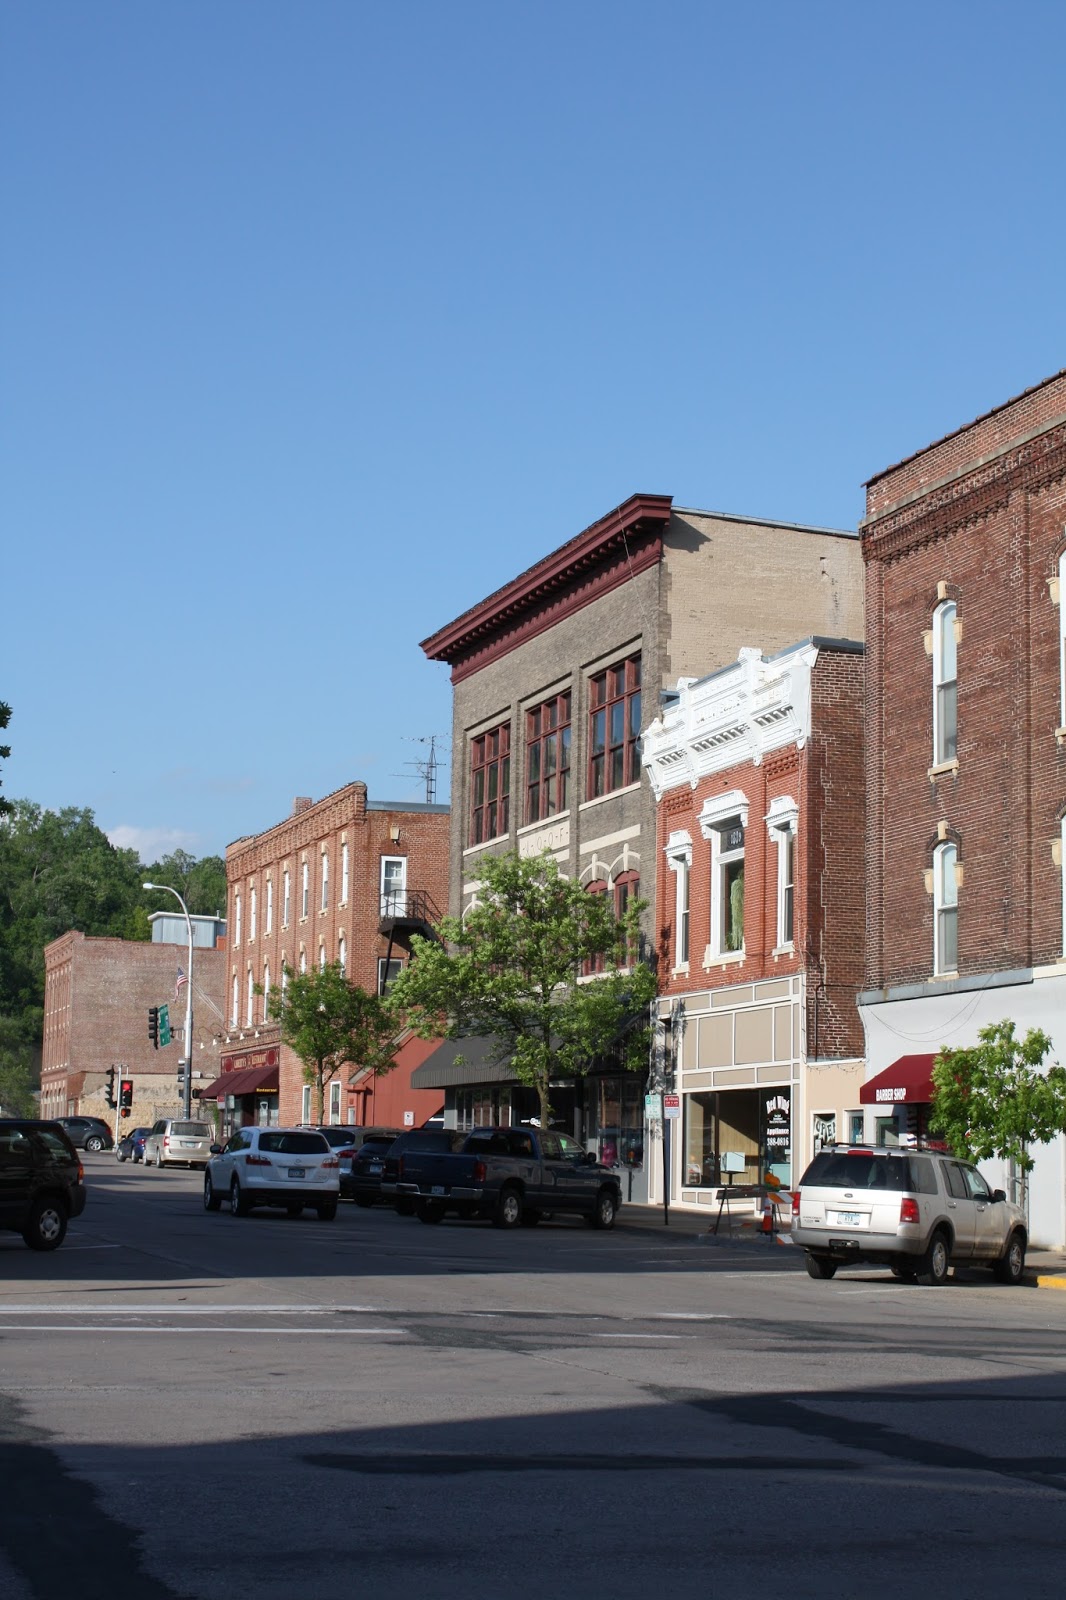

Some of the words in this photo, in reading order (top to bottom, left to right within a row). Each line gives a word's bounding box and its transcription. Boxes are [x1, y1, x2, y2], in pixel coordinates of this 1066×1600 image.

[876, 1089, 893, 1101] BARBER
[894, 1088, 906, 1101] SHOP
[766, 1097, 776, 1114] Red
